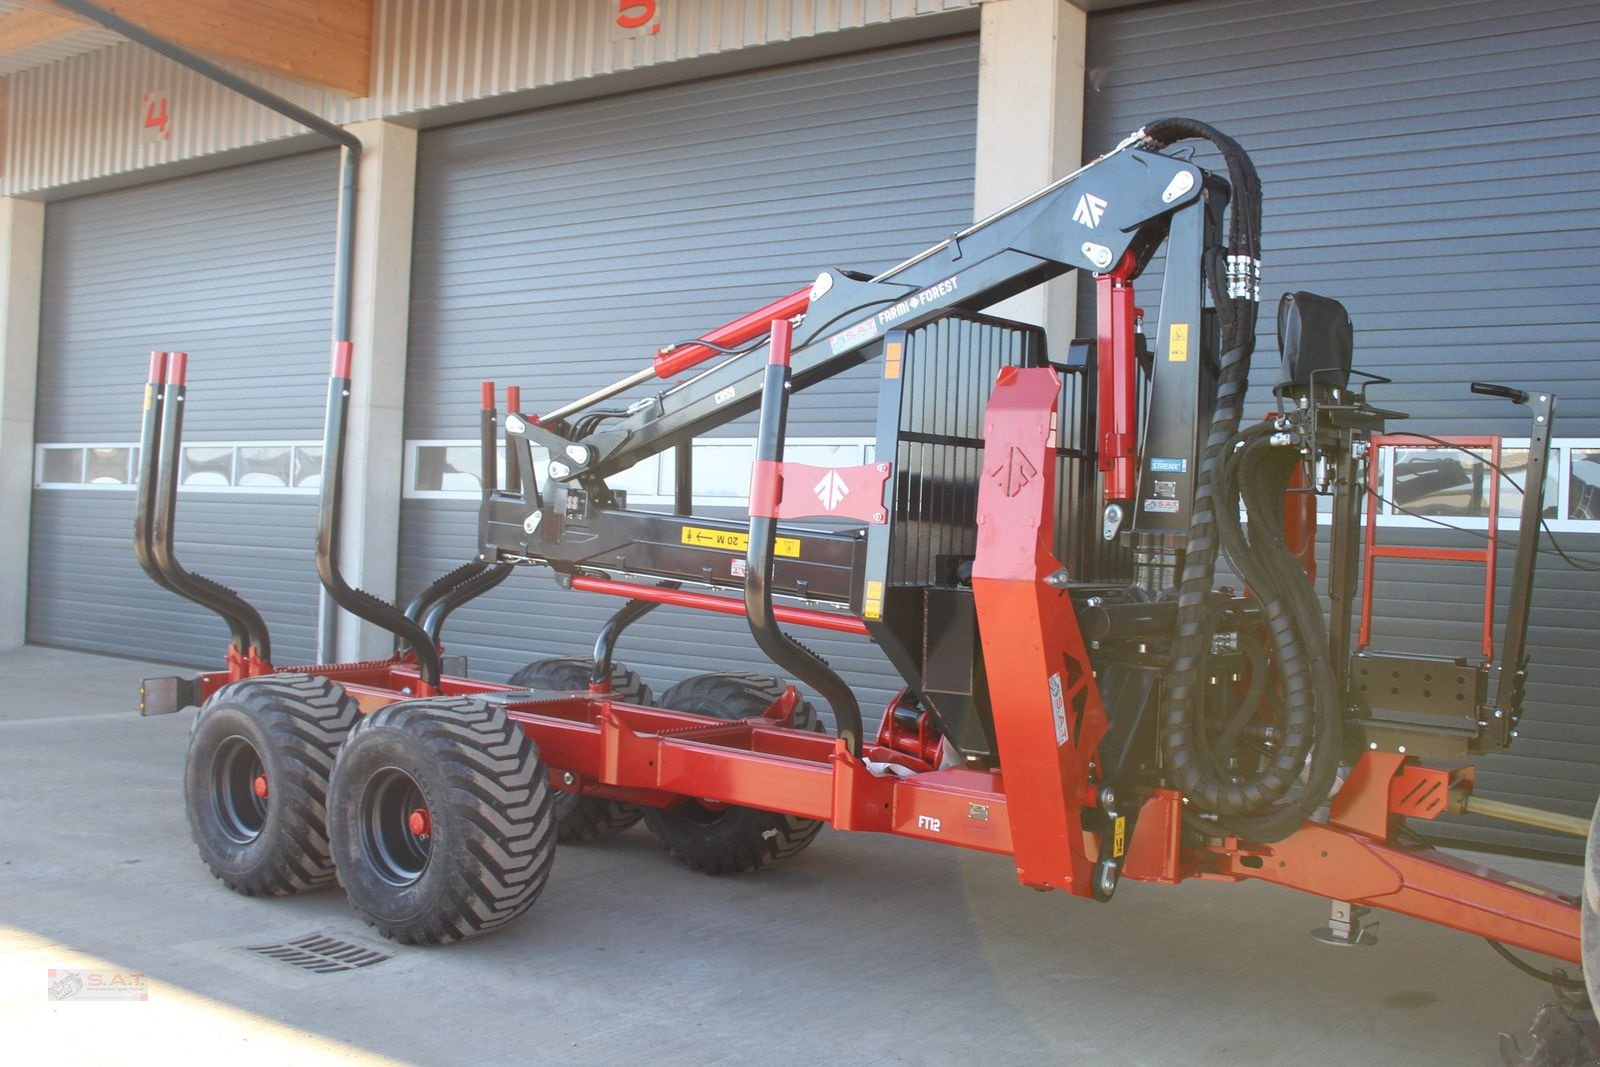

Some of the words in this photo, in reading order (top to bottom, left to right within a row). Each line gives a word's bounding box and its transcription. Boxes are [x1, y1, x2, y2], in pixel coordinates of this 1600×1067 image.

[879, 301, 910, 325] FARMI
[919, 276, 958, 305] FOREST
[716, 535, 725, 545] M
[728, 536, 739, 546] 20
[918, 815, 941, 832] FT12
